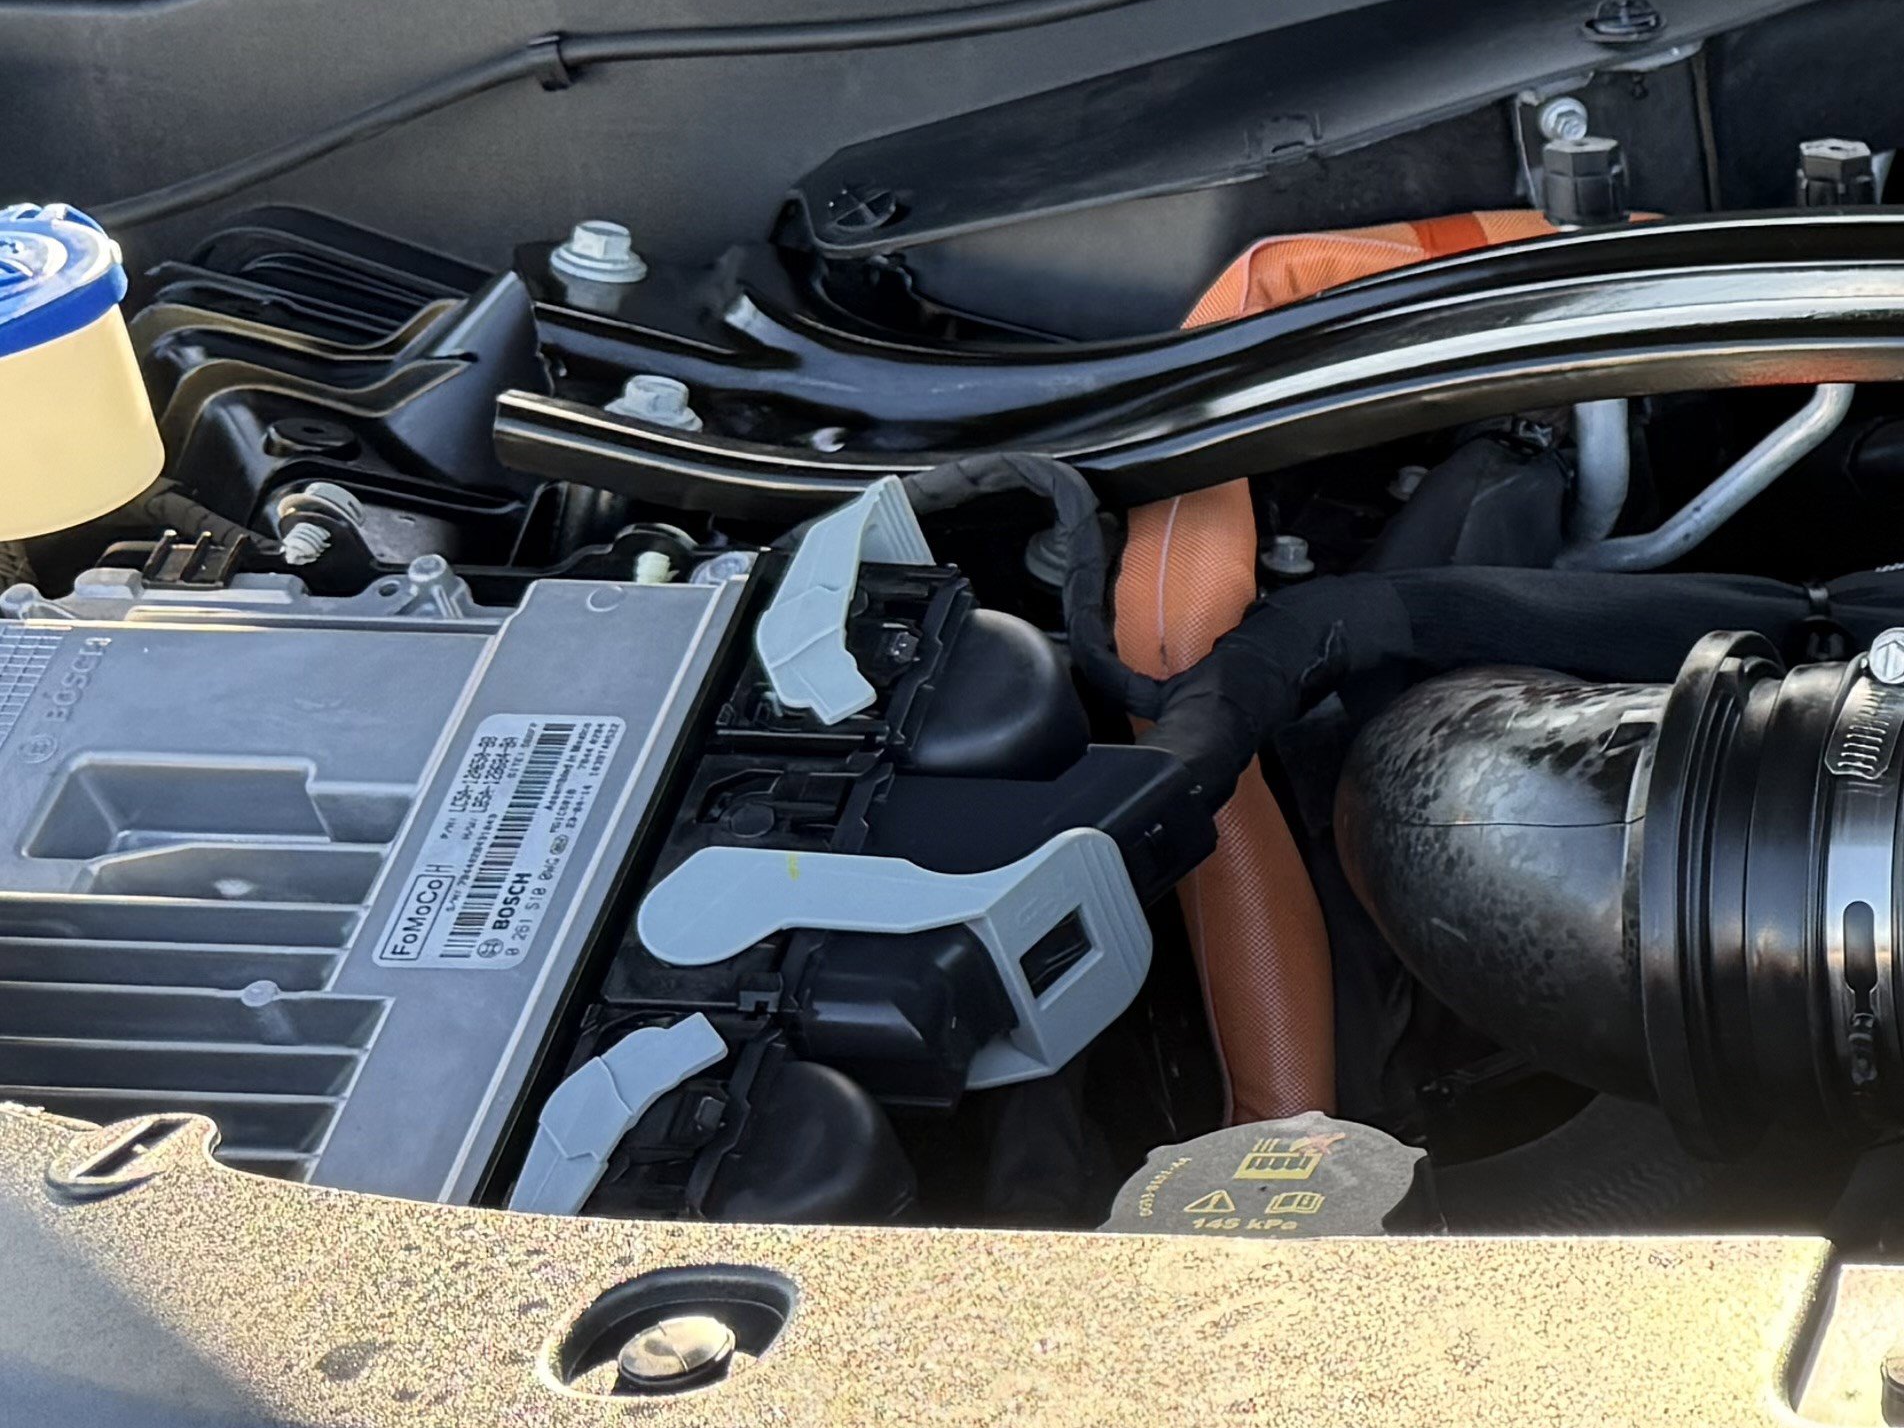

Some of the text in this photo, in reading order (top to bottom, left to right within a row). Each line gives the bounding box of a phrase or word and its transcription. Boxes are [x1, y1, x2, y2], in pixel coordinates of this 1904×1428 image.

[390, 879, 445, 955] FoMoCo
[492, 872, 532, 929] BOSCH
[1193, 1218, 1298, 1230] 145 kPa
